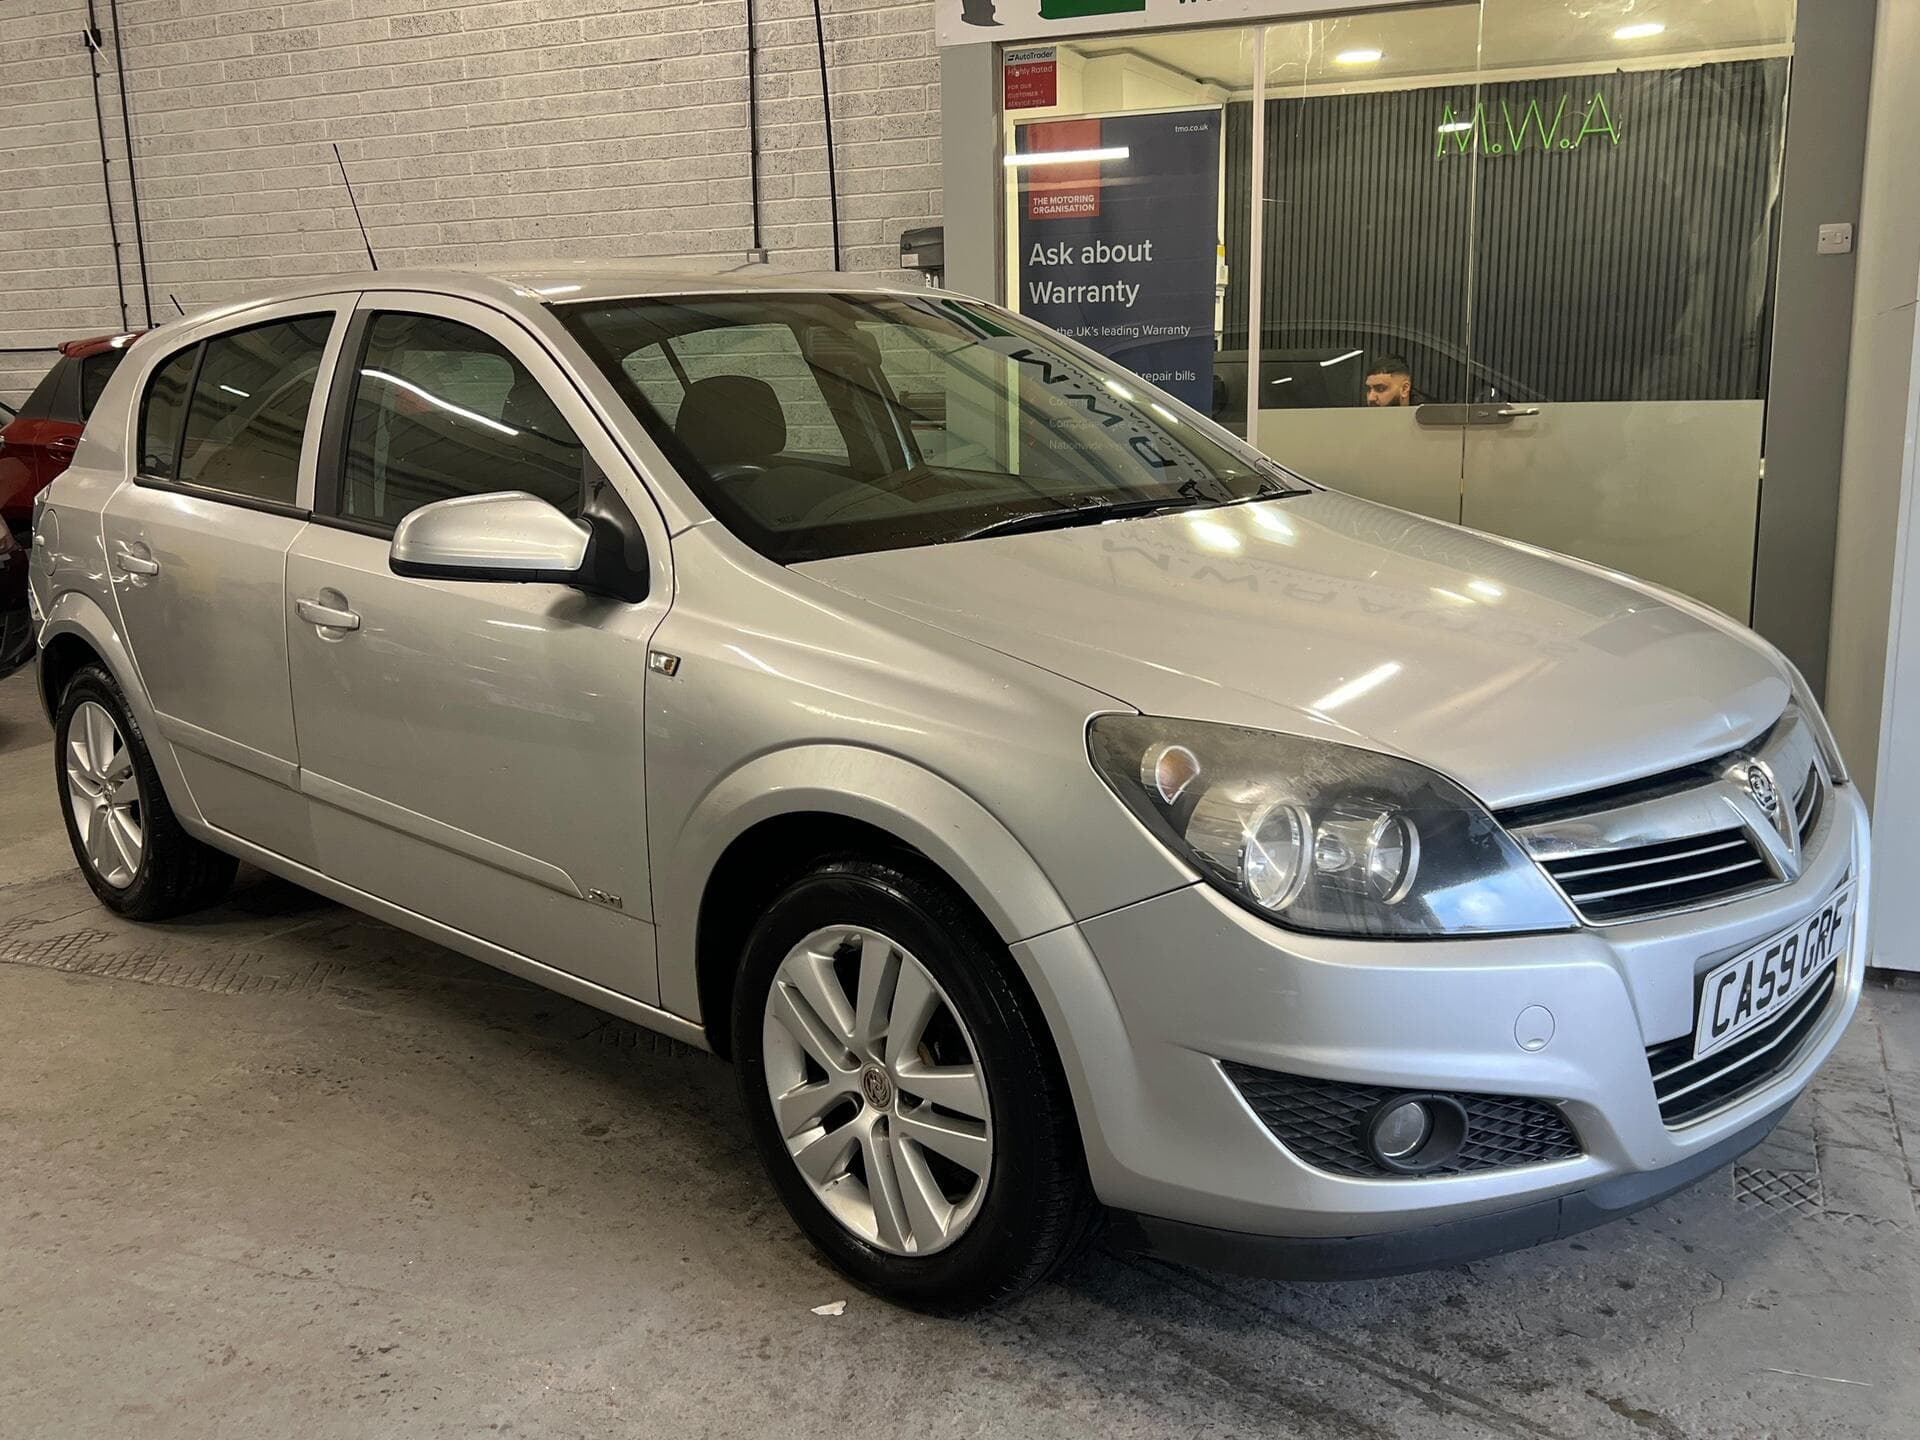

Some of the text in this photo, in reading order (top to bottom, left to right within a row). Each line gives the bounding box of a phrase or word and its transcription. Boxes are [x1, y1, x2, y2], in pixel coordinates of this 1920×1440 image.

[1015, 50, 1053, 61] AutoTrader
[1031, 64, 1053, 74] Rated
[1175, 123, 1209, 133] tmo.co.uk
[1436, 92, 1618, 158] M.W.A
[1033, 194, 1095, 206] THE MOTORING
[1033, 203, 1095, 214] ORGANISATION
[1029, 239, 1153, 266] Ask about
[1029, 280, 1140, 308] Warranty
[1076, 326, 1099, 337] UK's
[1101, 325, 1139, 338] leading
[1142, 324, 1192, 337] Warranty
[1142, 371, 1172, 382] repair
[1175, 370, 1196, 381] bills
[1711, 891, 1849, 1039] CA59 GRF
